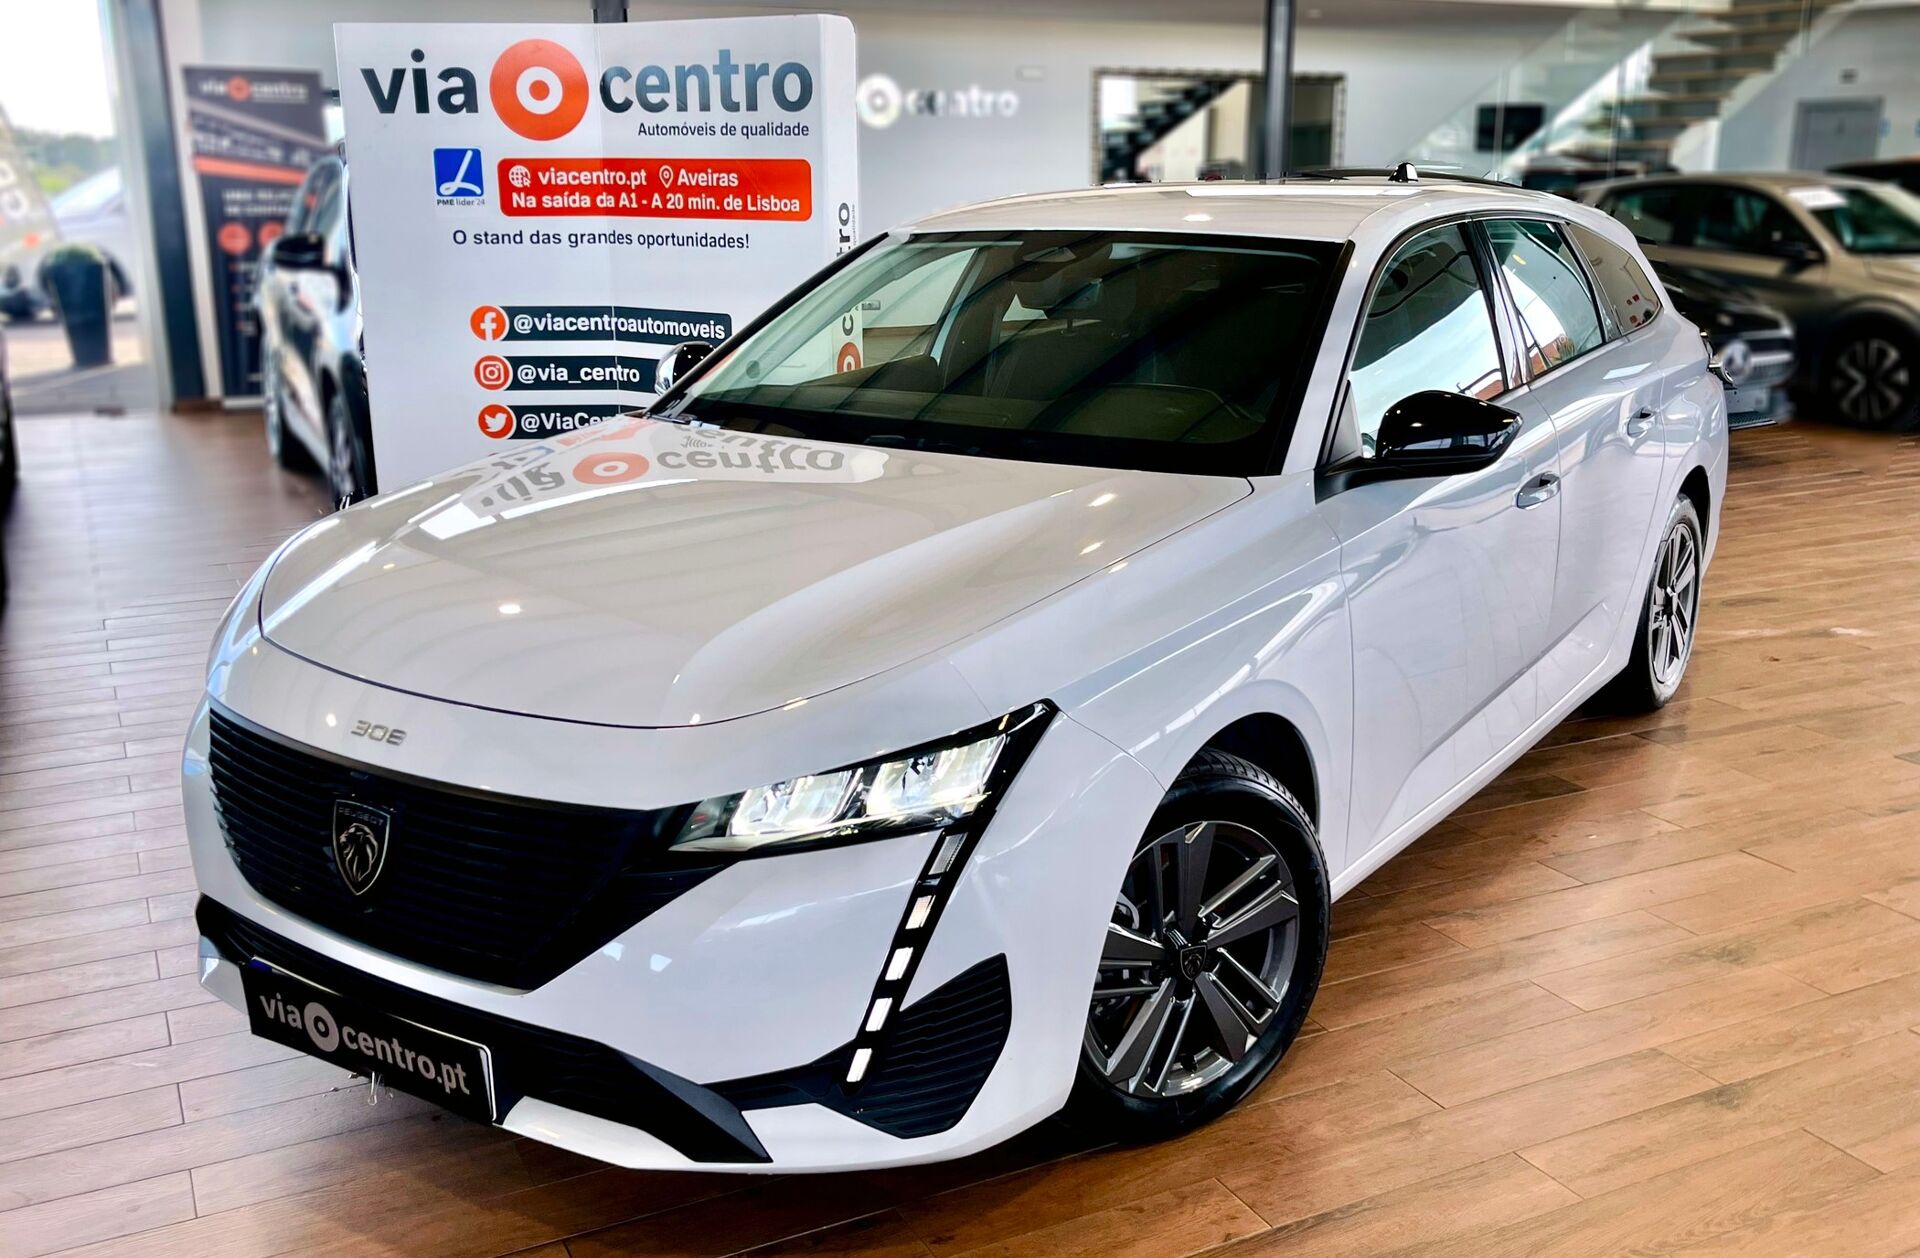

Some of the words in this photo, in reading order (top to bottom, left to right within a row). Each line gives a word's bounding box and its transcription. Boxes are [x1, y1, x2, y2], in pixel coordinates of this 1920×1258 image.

[360, 48, 479, 115] via
[600, 49, 813, 113] centro
[638, 122, 716, 137] Automóveis
[720, 122, 737, 137] de
[741, 122, 809, 139] qualidade
[538, 167, 647, 189] viacentro.pt
[677, 168, 739, 187] Aveiras
[512, 192, 536, 208] Na
[542, 191, 591, 208] saída
[596, 192, 615, 208] da
[619, 192, 638, 208] A1
[651, 193, 662, 209] A
[666, 193, 683, 209] 20
[688, 194, 720, 210] min.
[723, 195, 742, 211] de
[747, 195, 800, 212] Lisboa
[453, 229, 467, 245] O
[473, 229, 523, 245] stand
[529, 229, 562, 245] das
[568, 229, 633, 248] grandes
[637, 231, 749, 249] oportunidades!
[513, 312, 725, 340] @viacentroautomoveis
[517, 362, 640, 386] @via_centro
[351, 720, 407, 746] 308
[259, 992, 302, 1031] via
[342, 1025, 470, 1095] centro.pt
